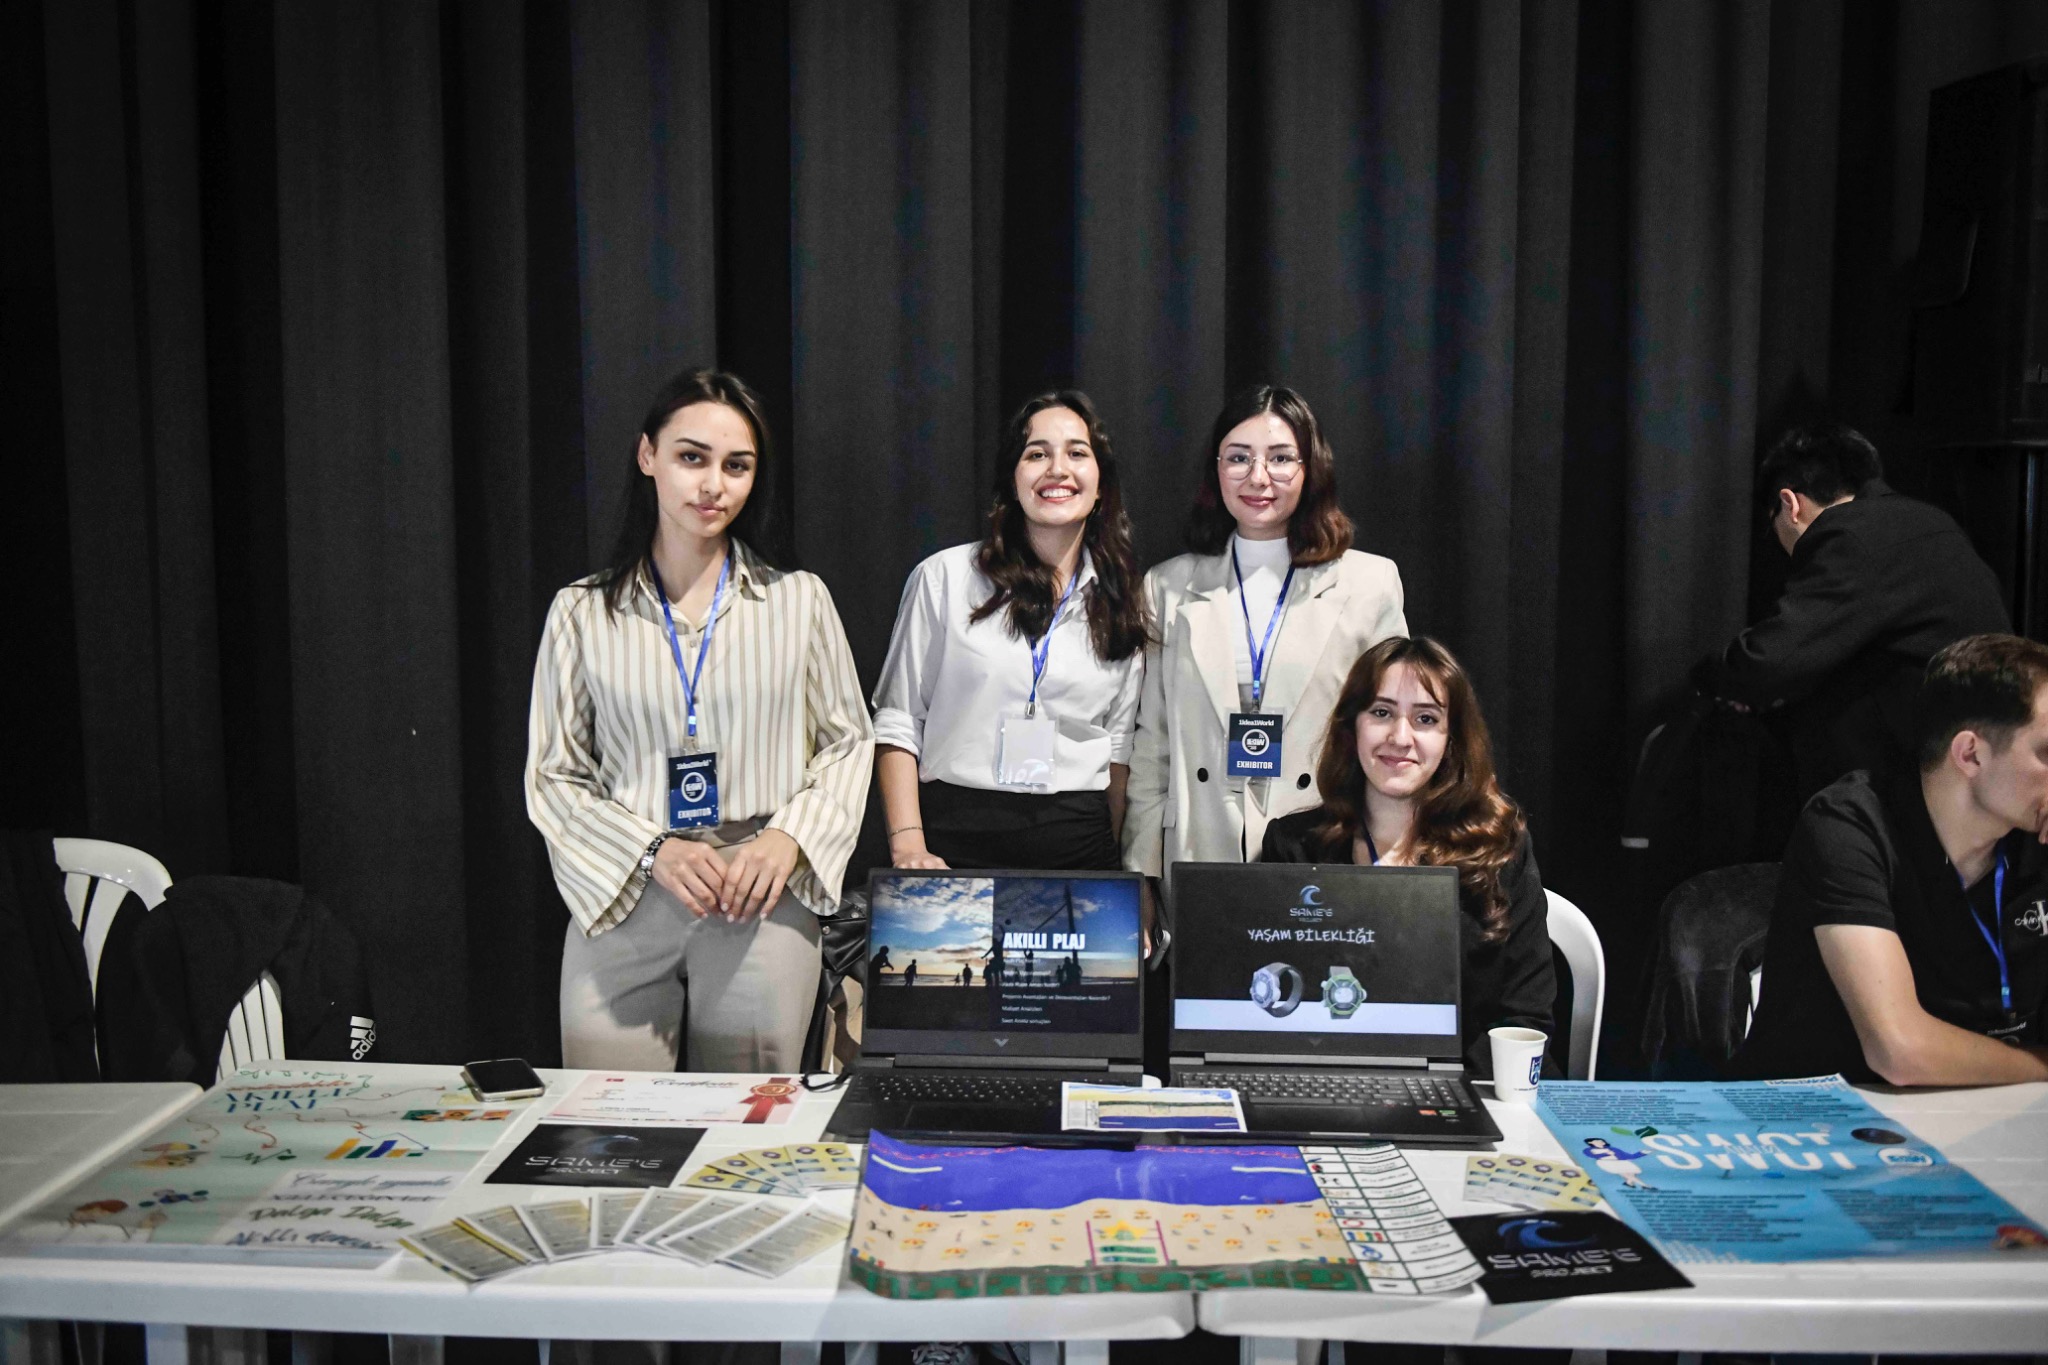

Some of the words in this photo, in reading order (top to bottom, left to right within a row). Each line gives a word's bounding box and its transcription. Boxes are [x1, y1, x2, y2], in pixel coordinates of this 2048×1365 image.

[1236, 760, 1273, 770] EXHIBITOR
[1003, 932, 1048, 949] AKILLI
[1052, 933, 1086, 950] PLAJ
[1248, 928, 1292, 943] YAŞAM
[1295, 927, 1375, 944] BİLEKLİĞİ
[352, 1023, 377, 1061] adid
[1641, 1132, 1857, 1171] SWOT
[1530, 1265, 1613, 1278] PROJECT
